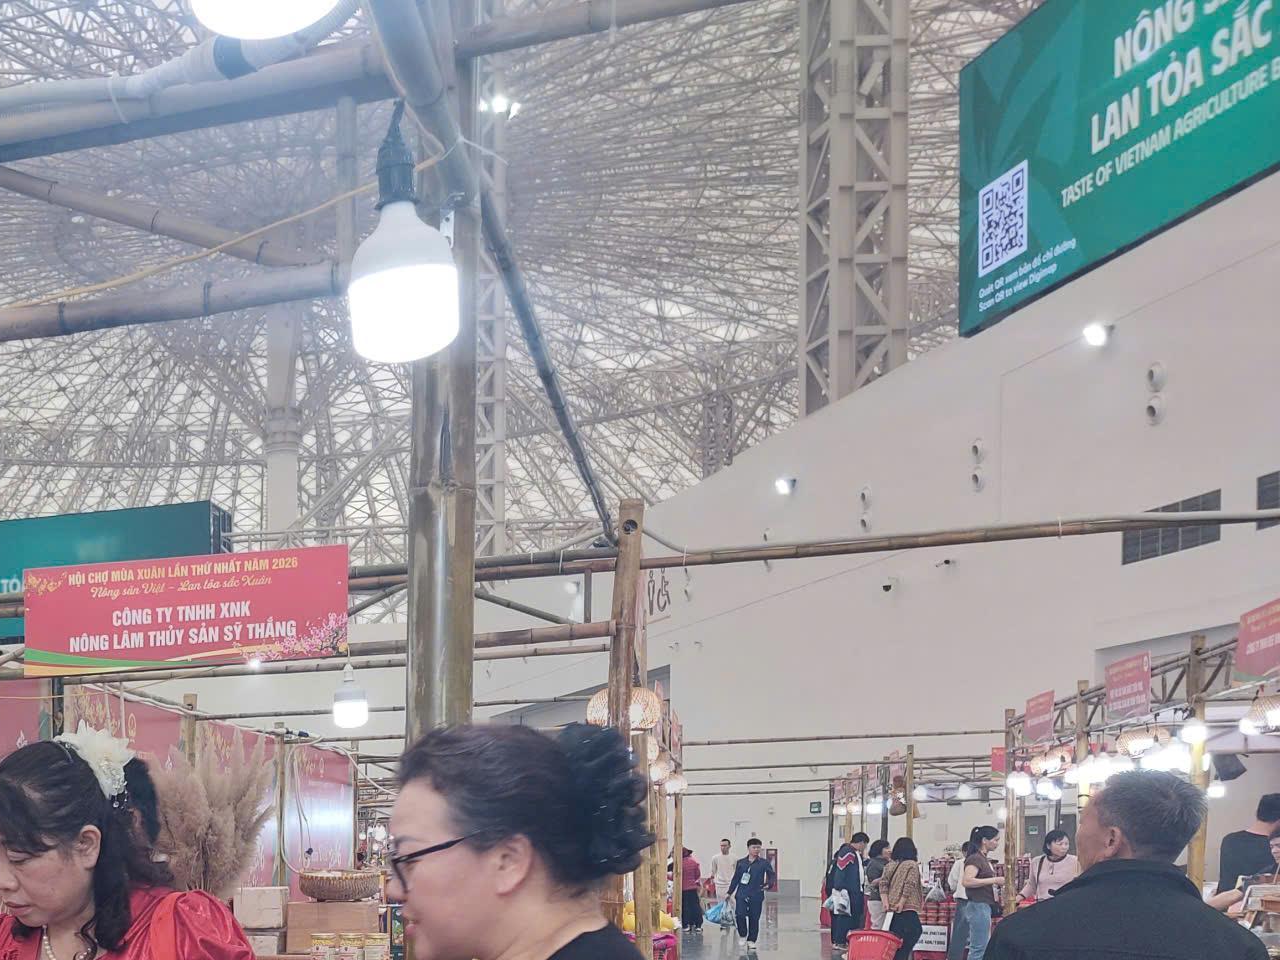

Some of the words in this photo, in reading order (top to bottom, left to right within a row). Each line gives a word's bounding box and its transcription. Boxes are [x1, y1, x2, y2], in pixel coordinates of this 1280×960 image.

[1114, 0, 1196, 79] NÔNG
[1091, 86, 1141, 155] LAN
[1146, 45, 1205, 117] TỎA
[1210, 0, 1273, 76] SẮC
[1061, 172, 1095, 208] TASTE
[1095, 161, 1113, 187] OF
[1114, 124, 1172, 176] VIETNAM
[1173, 63, 1270, 141] AGRICULTURE
[68, 572, 87, 587] HỘI
[87, 570, 110, 585] CHỢ
[111, 567, 135, 583] MÙA
[136, 565, 167, 581] XUÂN
[167, 560, 189, 578] LẦN
[190, 561, 213, 576] THỨ
[213, 558, 243, 574] NHẤT
[244, 558, 270, 573] NĂM
[271, 556, 299, 570] 2026
[90, 586, 121, 601] Nông
[112, 606, 153, 627] CÔNG
[155, 606, 174, 625] TY
[176, 603, 217, 622] TNHH
[219, 600, 252, 619] XNK
[69, 632, 110, 653] NÔNG
[113, 630, 145, 650] LÂM
[147, 624, 185, 647] THỦY
[188, 624, 220, 645] SẢN
[223, 620, 245, 641] SỸ
[246, 616, 298, 640] THẮNG
